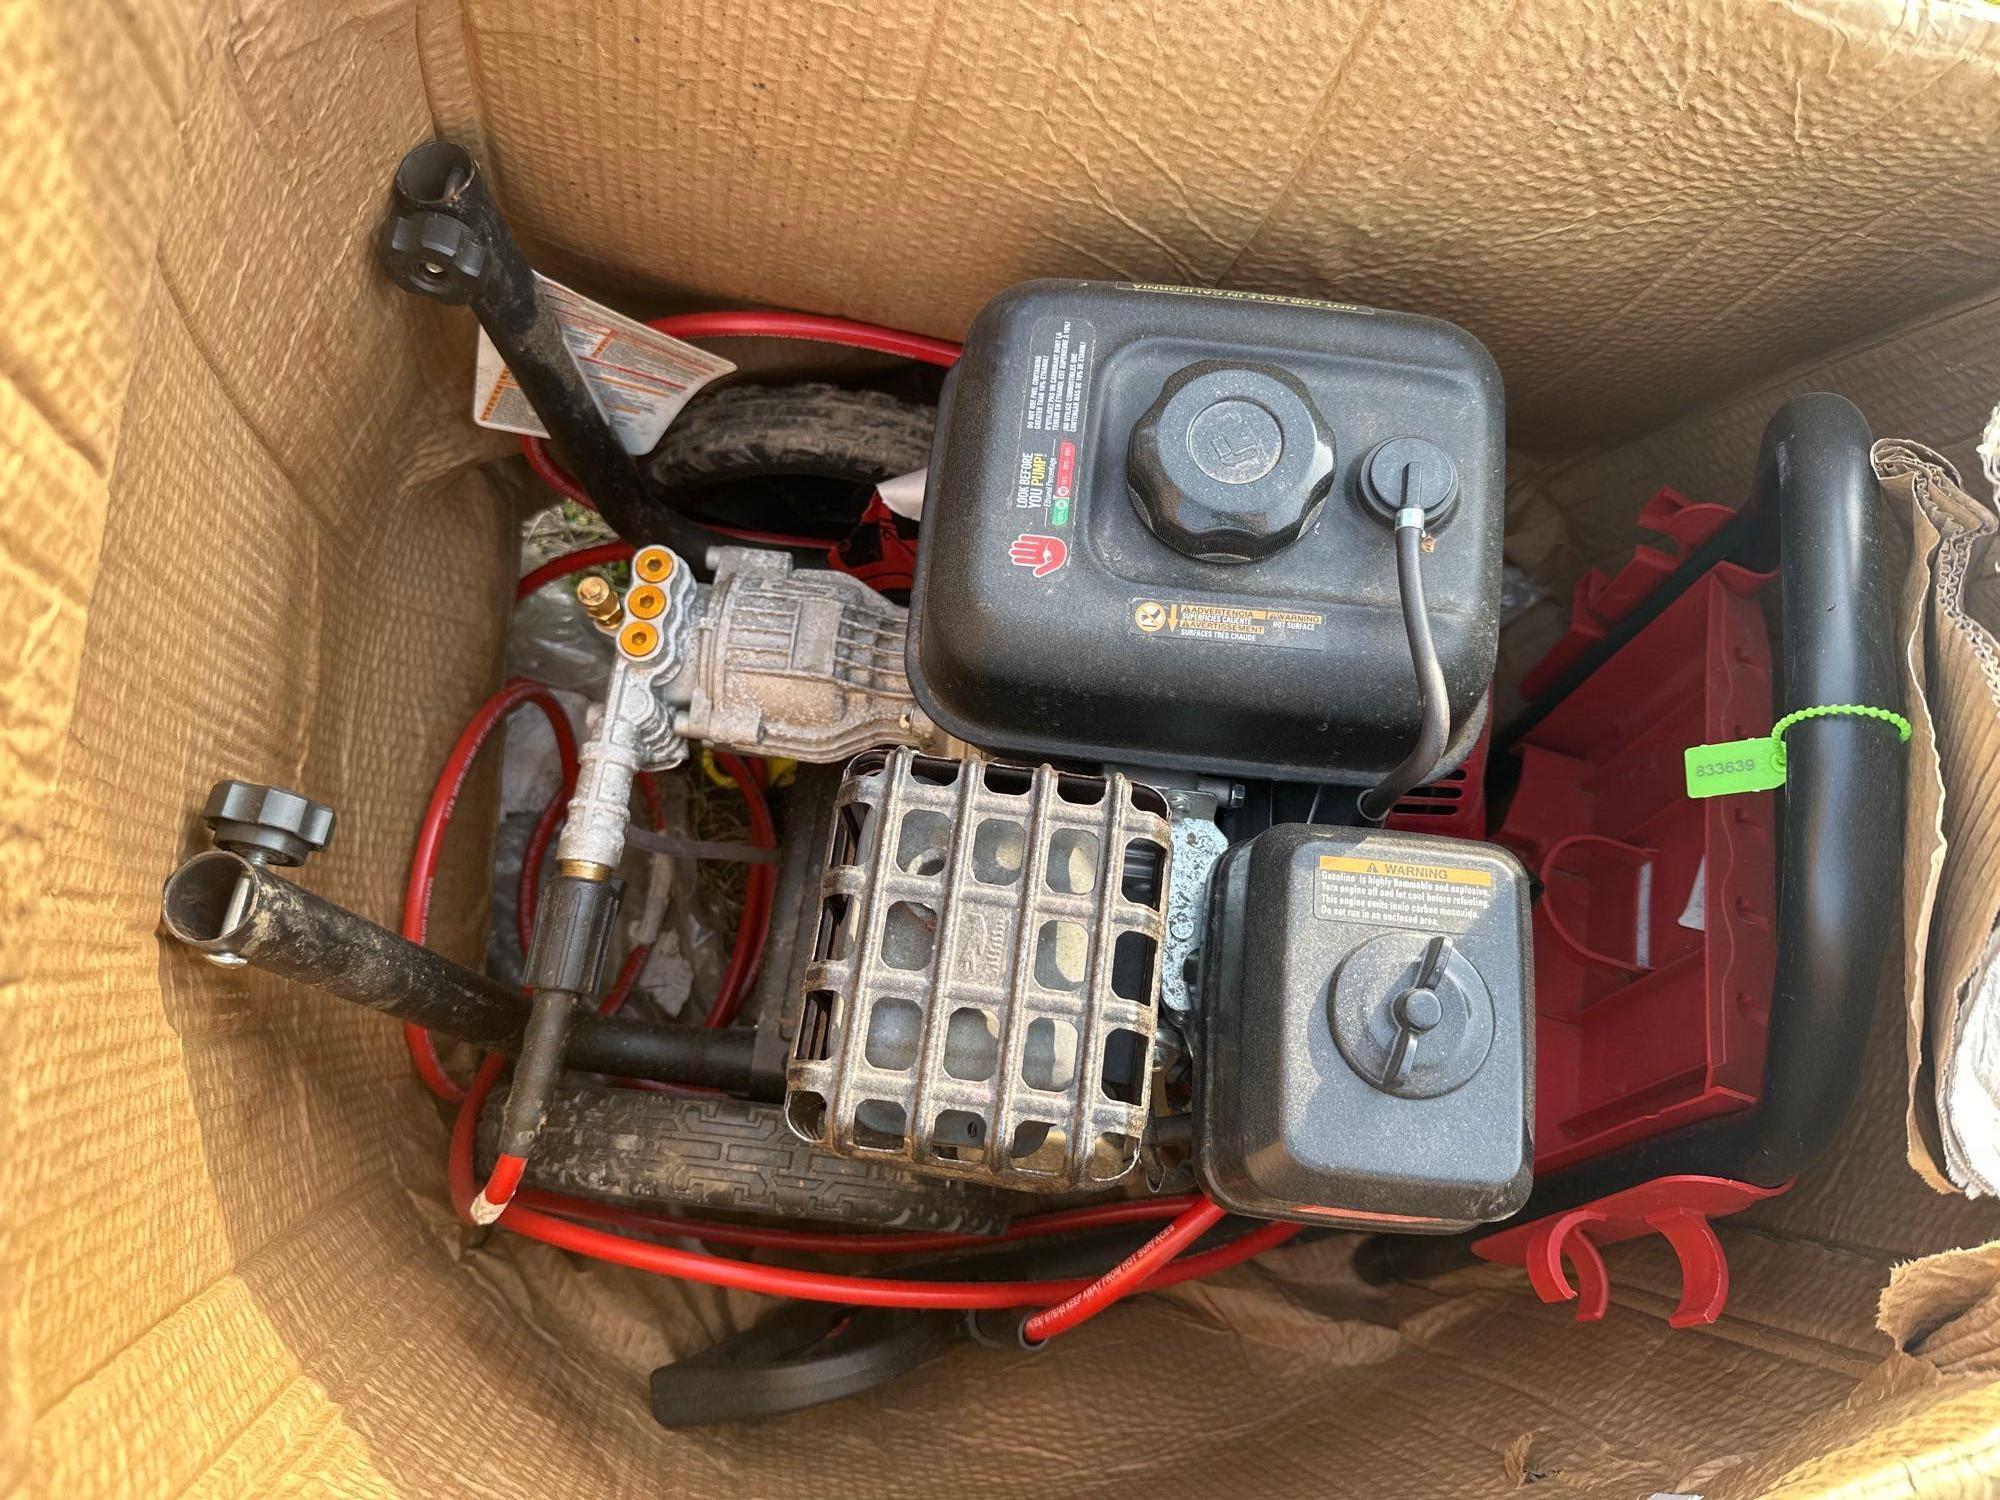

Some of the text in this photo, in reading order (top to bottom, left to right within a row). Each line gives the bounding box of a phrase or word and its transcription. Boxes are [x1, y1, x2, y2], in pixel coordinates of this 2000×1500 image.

[1017, 451, 1031, 508] LOOK BEFORE
[1029, 452, 1045, 509] YOU PUMP!
[1043, 456, 1056, 506] Ethanol Percentage
[1192, 606, 1253, 617] ADVERTENCIA
[1276, 613, 1319, 623] WARNING
[1180, 629, 1212, 637] SURFACES
[1230, 633, 1256, 641] CHAUDE
[1190, 621, 1262, 633] AVERTISSEMENT
[1287, 622, 1314, 630] SURFACE
[1696, 759, 1755, 777] 833639
[1384, 863, 1448, 879] WARNING
[1321, 871, 1491, 897] Gasoline is highly flammable and explosive.
[1320, 881, 1490, 909] Turn engine off and let cool before refueling.
[1320, 905, 1331, 914] Do
[1333, 907, 1345, 916] not
[1347, 909, 1360, 917] run
[1362, 909, 1370, 918] in
[1382, 912, 1417, 923] enclosed
[1419, 917, 1439, 926] area.
[1321, 894, 1479, 920] This engine emits toxic carbon monoxide.
[1065, 1223, 1175, 1310] KEEP AWAY FROM HOT SURFACES
